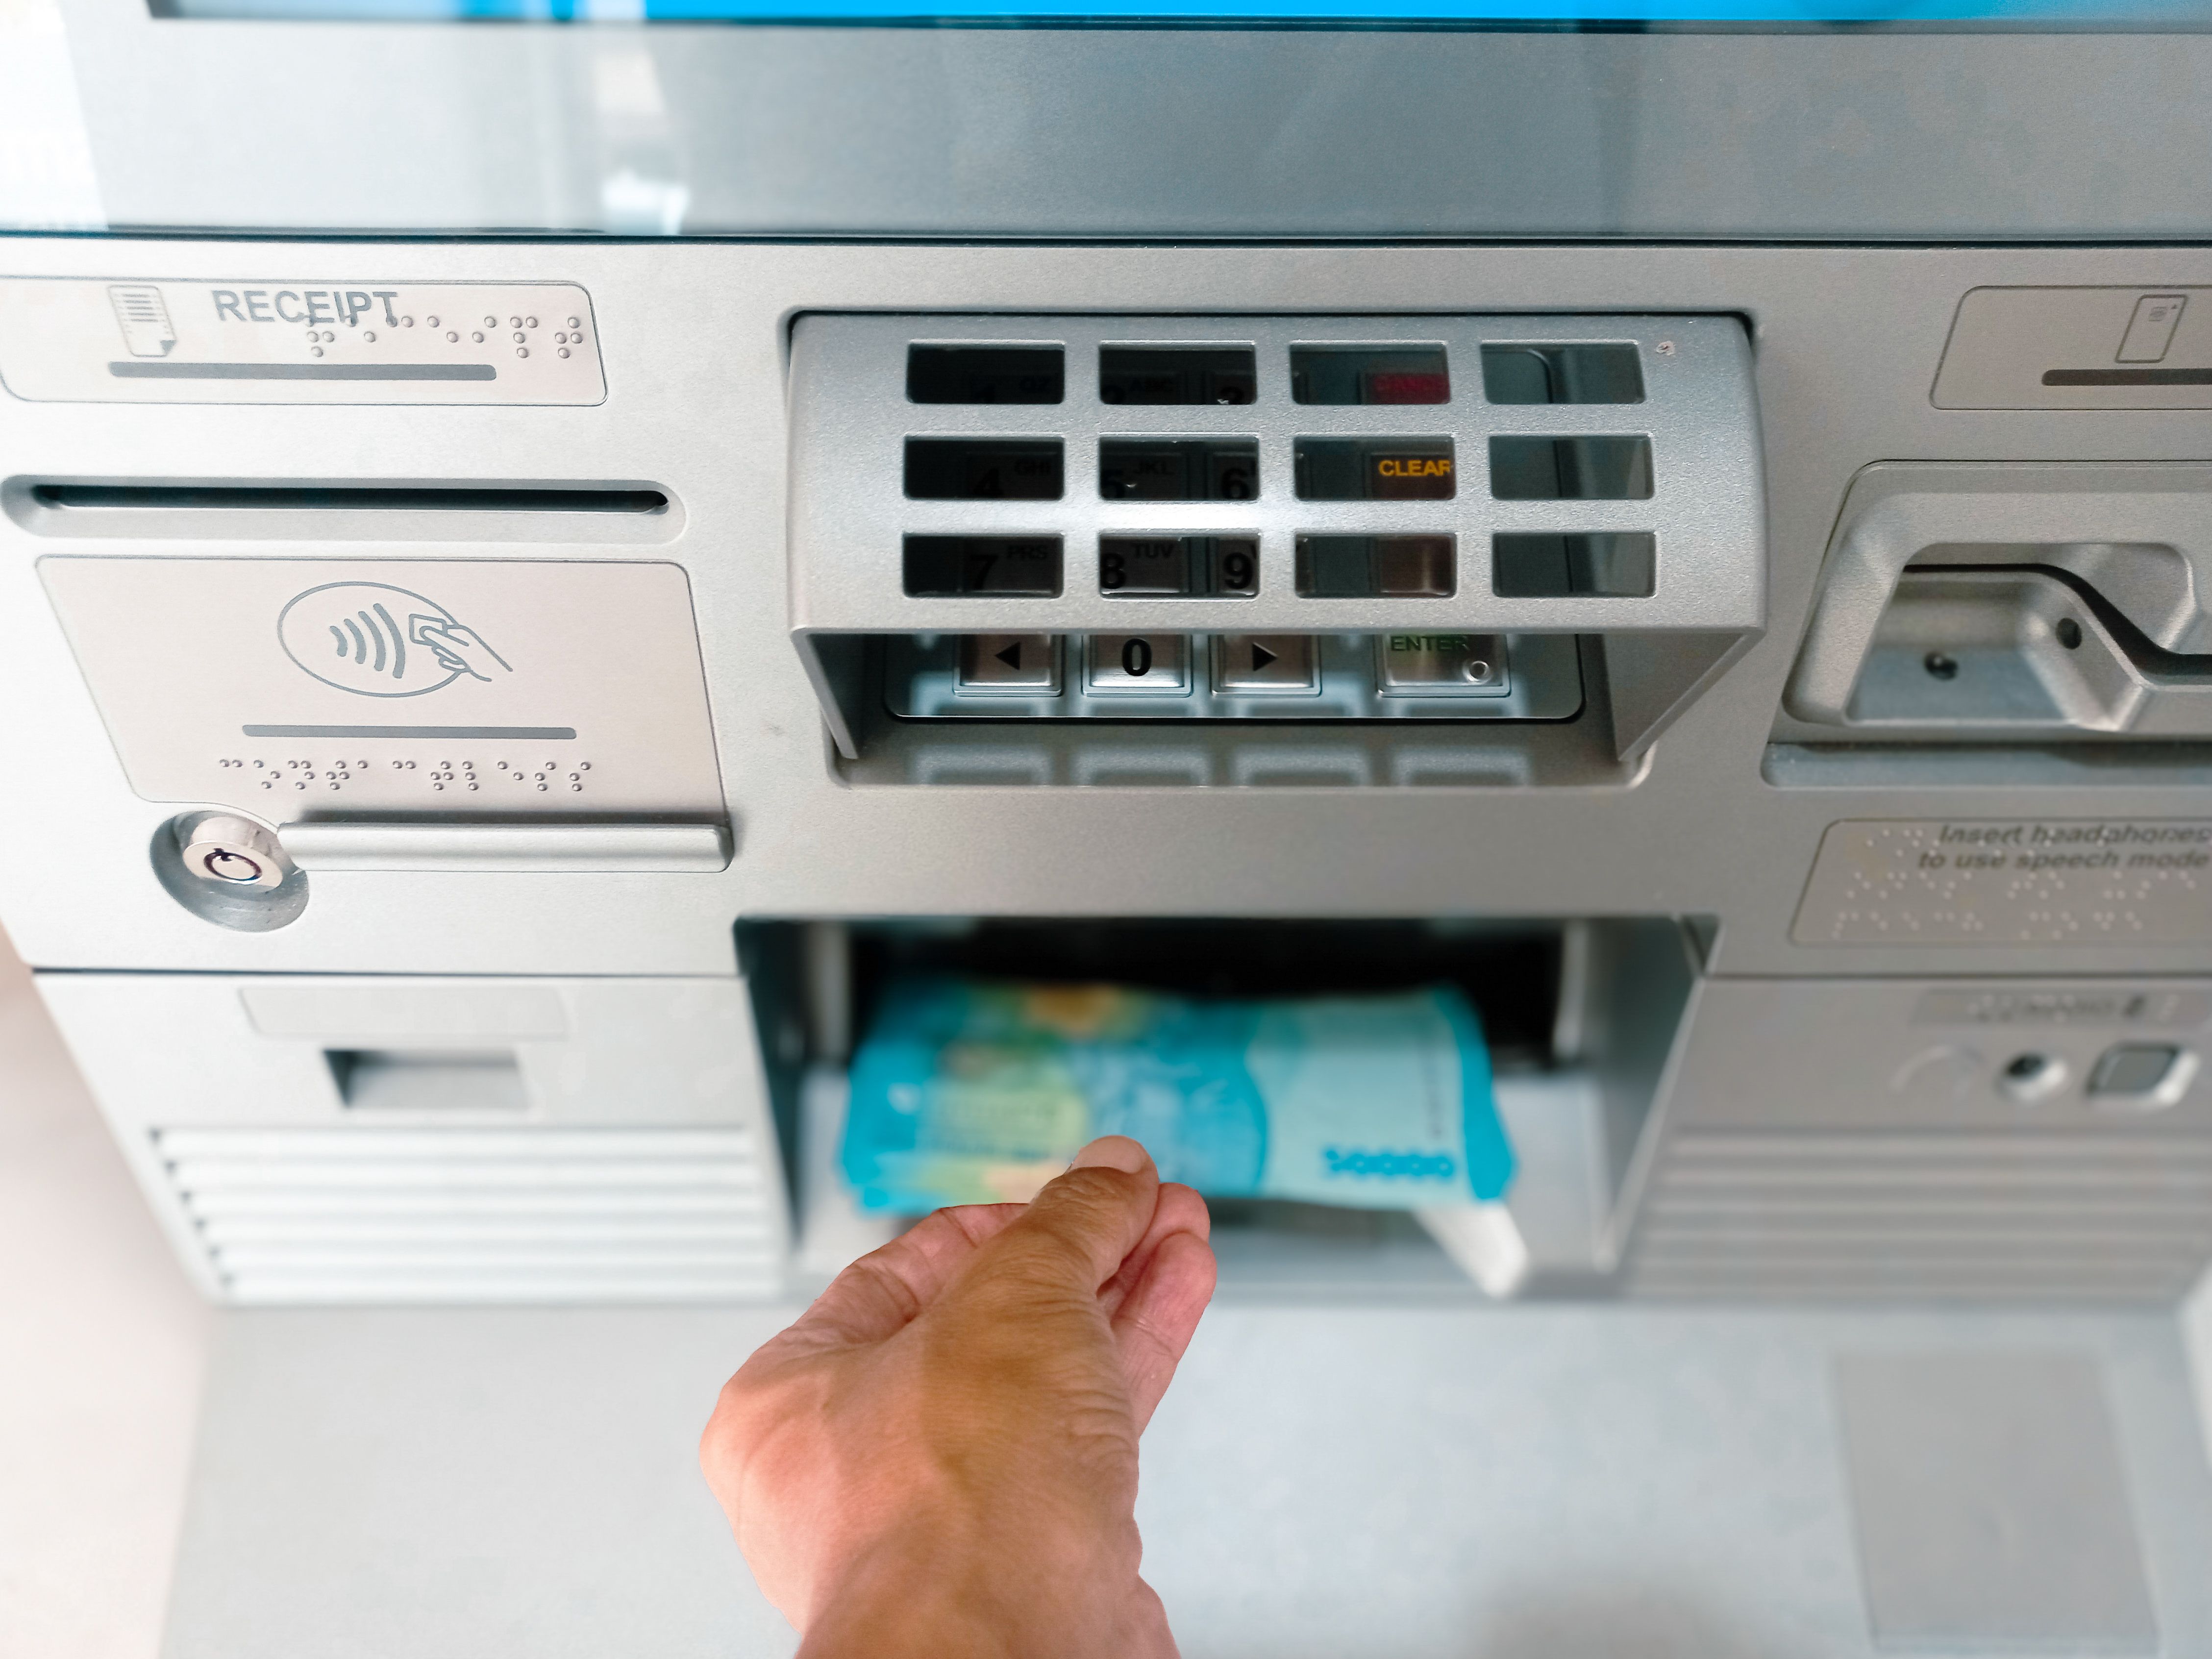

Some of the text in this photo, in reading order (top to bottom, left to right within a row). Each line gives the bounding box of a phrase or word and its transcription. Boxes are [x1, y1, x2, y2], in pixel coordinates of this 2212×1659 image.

[212, 290, 398, 327] RECEIPT
[1133, 460, 1174, 475] JKL
[1378, 459, 1451, 476] CLEAR
[1220, 468, 1249, 498] 6
[1006, 545, 1048, 560] PRS
[1131, 543, 1174, 559] TUV
[968, 554, 998, 590] 7
[1101, 552, 1126, 590] 8
[1223, 553, 1252, 590] 9
[1390, 635, 1469, 651] ENTER
[1121, 638, 1152, 677] 0
[1939, 824, 2023, 845] Insert
[1918, 848, 2209, 872] to use speech mode
